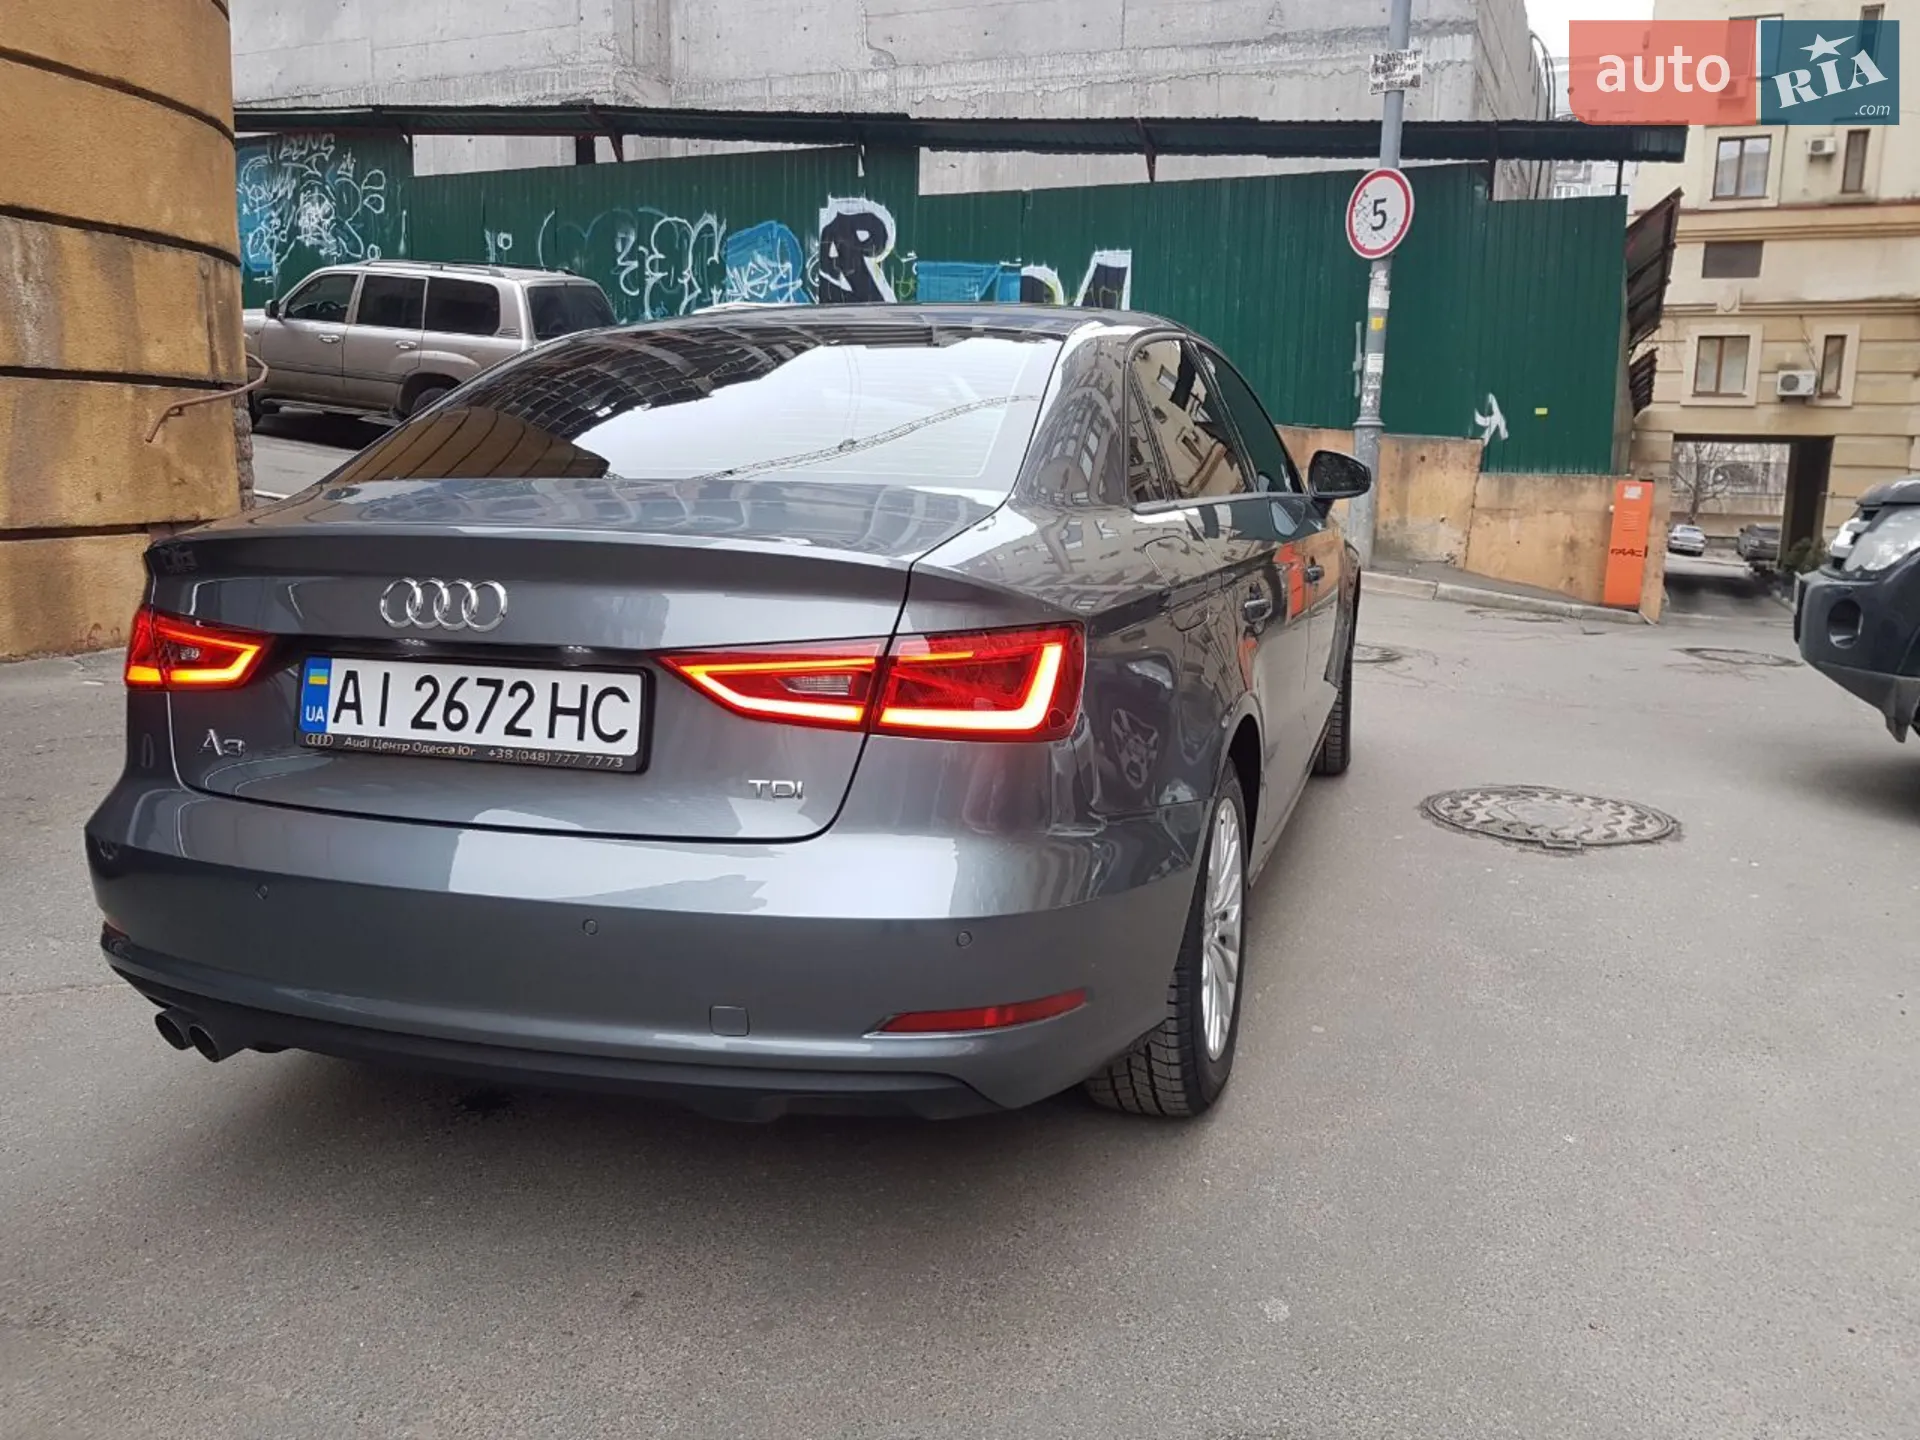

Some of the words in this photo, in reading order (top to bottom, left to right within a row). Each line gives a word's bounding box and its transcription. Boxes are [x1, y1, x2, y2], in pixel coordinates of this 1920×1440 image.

[1371, 198, 1388, 231] 5
[305, 705, 325, 723] UA
[410, 674, 536, 738] 2672
[547, 681, 631, 743] HC
[198, 728, 246, 756] A3
[344, 736, 370, 748] Audi
[372, 738, 411, 753] Центр
[412, 742, 456, 755] Одесса
[457, 744, 477, 756] Юг
[488, 748, 513, 759] +38
[515, 749, 551, 763] (048)
[554, 752, 580, 764] 777
[585, 754, 603, 766] 77
[606, 756, 624, 768] 73
[747, 779, 804, 800] TDI
